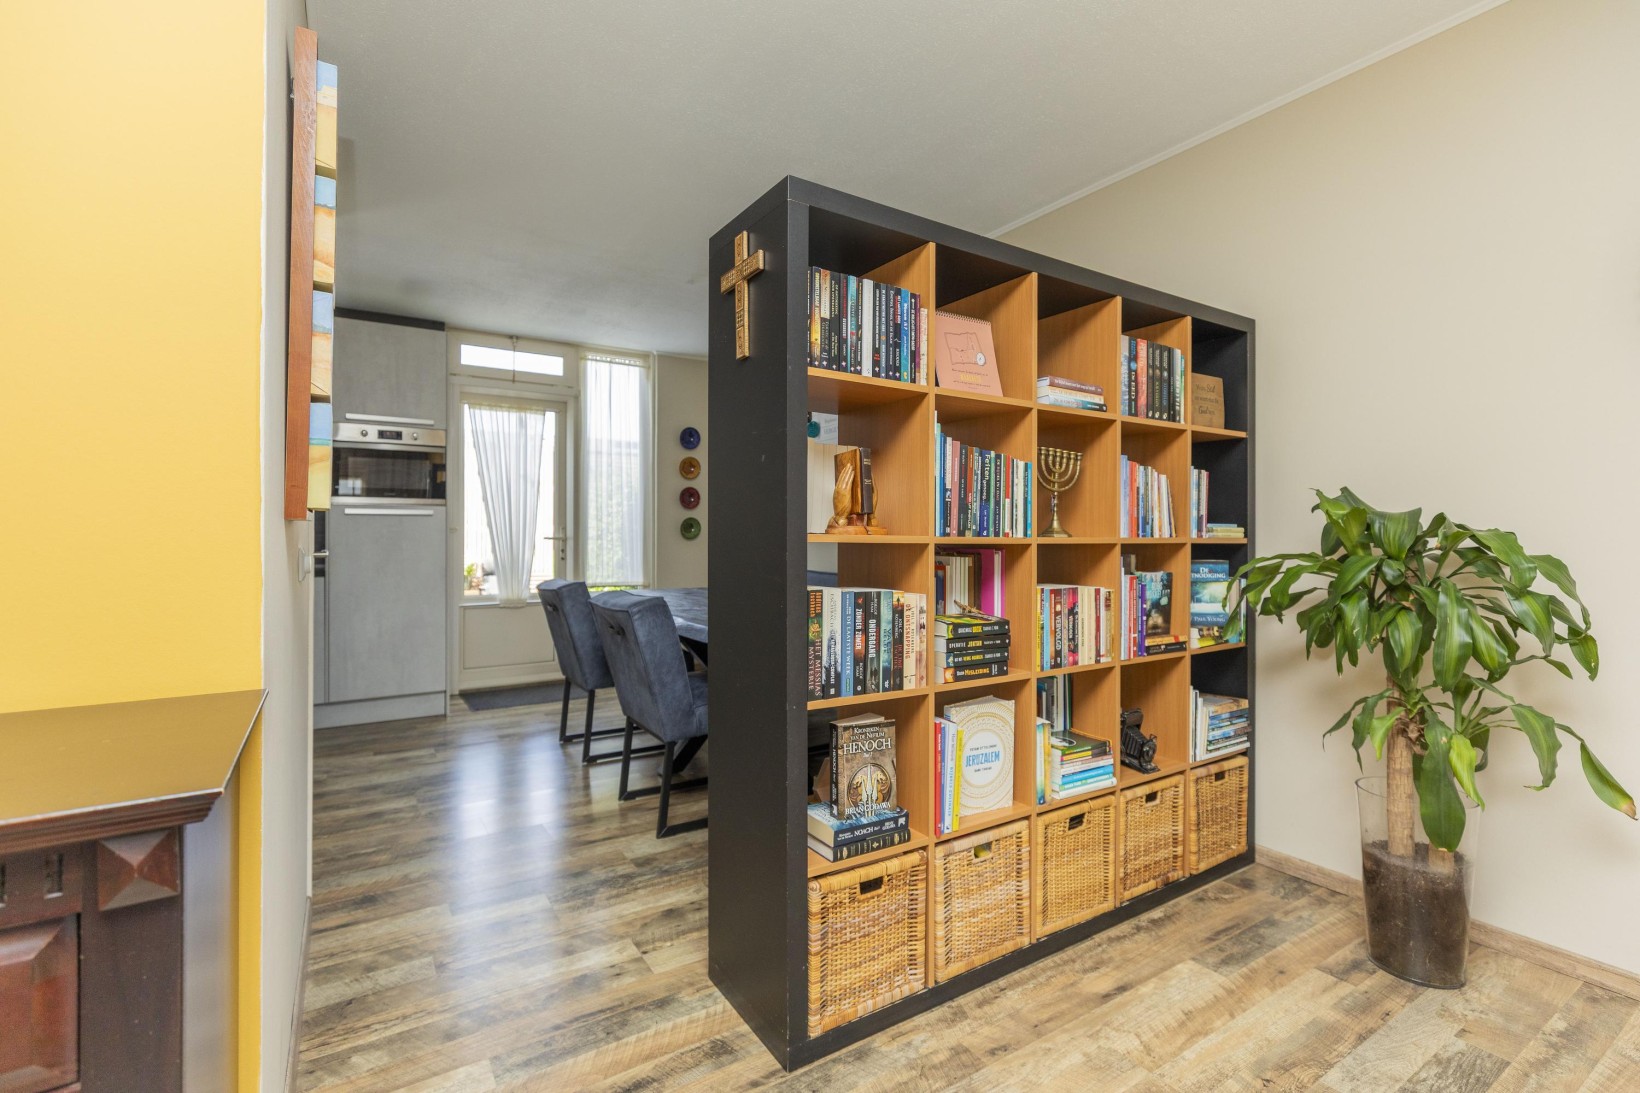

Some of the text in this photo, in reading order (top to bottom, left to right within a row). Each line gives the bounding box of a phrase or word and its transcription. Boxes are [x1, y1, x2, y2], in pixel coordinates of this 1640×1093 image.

[855, 608, 863, 630] ZONDER
[868, 619, 876, 658] ONDERGANG
[814, 659, 822, 697] MESSIAS
[843, 737, 892, 755] HENOCH
[965, 750, 1000, 767] JERUZALEM
